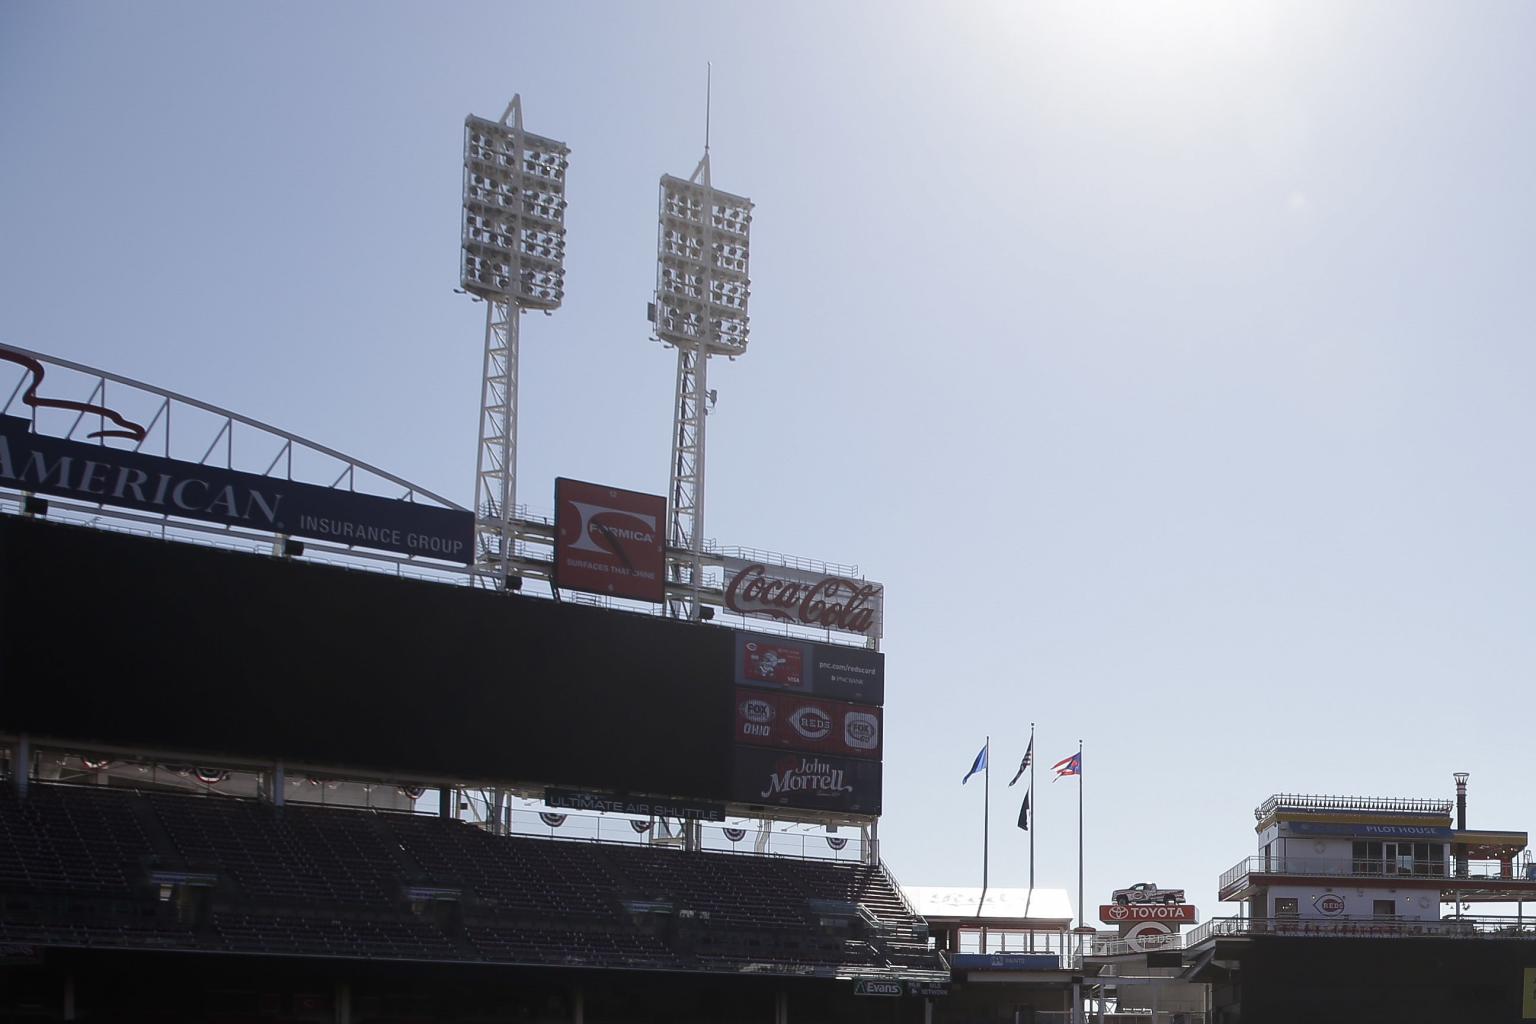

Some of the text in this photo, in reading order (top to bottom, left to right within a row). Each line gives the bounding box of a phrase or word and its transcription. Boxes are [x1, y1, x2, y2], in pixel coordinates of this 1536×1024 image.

[0, 435, 463, 555] AMERICAN INSURANCE GROUP
[724, 563, 882, 633] Coca-Cola
[743, 722, 771, 737] OHIO
[801, 717, 831, 729] REDS
[795, 758, 830, 775] John
[760, 768, 853, 798] Morrell
[549, 796, 719, 820] ULTIMATE AIR SHUTTLE
[1366, 825, 1437, 835] PILOT HOUSE
[1131, 907, 1184, 918] TOYOTA
[1322, 902, 1344, 911] REDS
[866, 981, 900, 994] Evans
